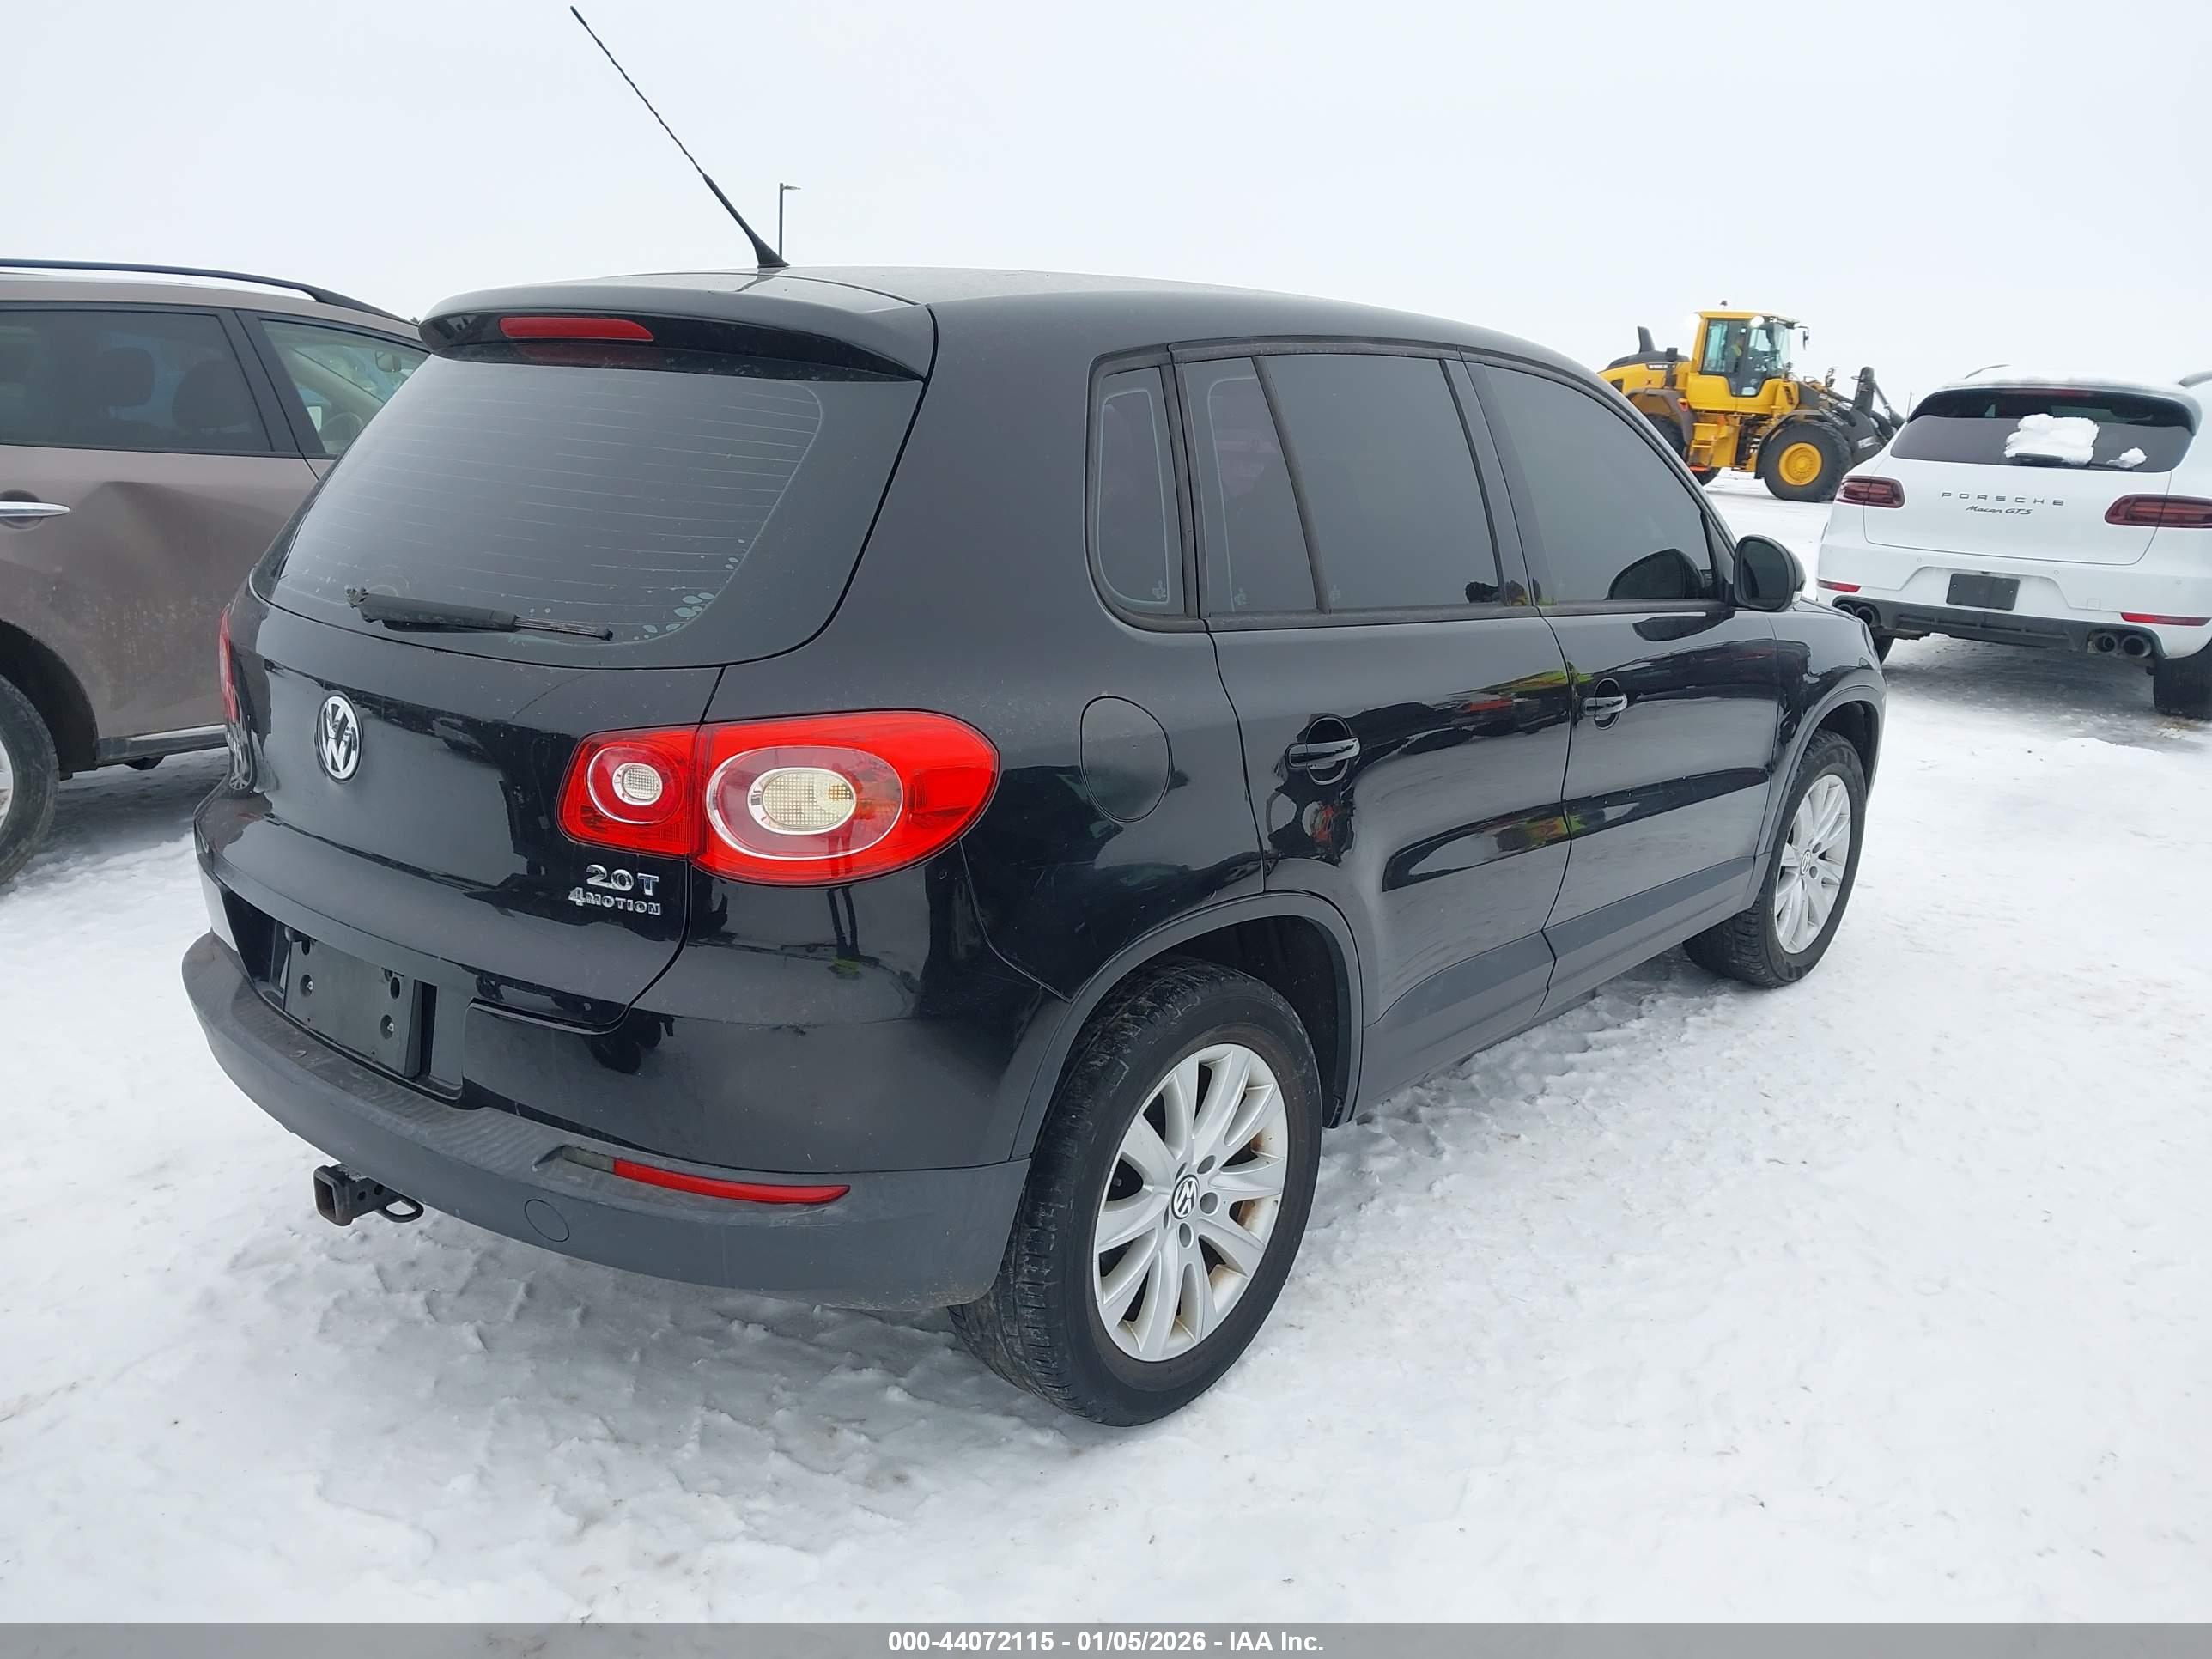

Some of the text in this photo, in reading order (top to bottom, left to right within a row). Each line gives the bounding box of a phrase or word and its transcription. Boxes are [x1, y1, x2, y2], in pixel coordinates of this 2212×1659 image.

[1941, 491, 2064, 507] PORSCHE
[1965, 505, 2033, 516] Macan GTS
[568, 886, 662, 916] 4MOTION
